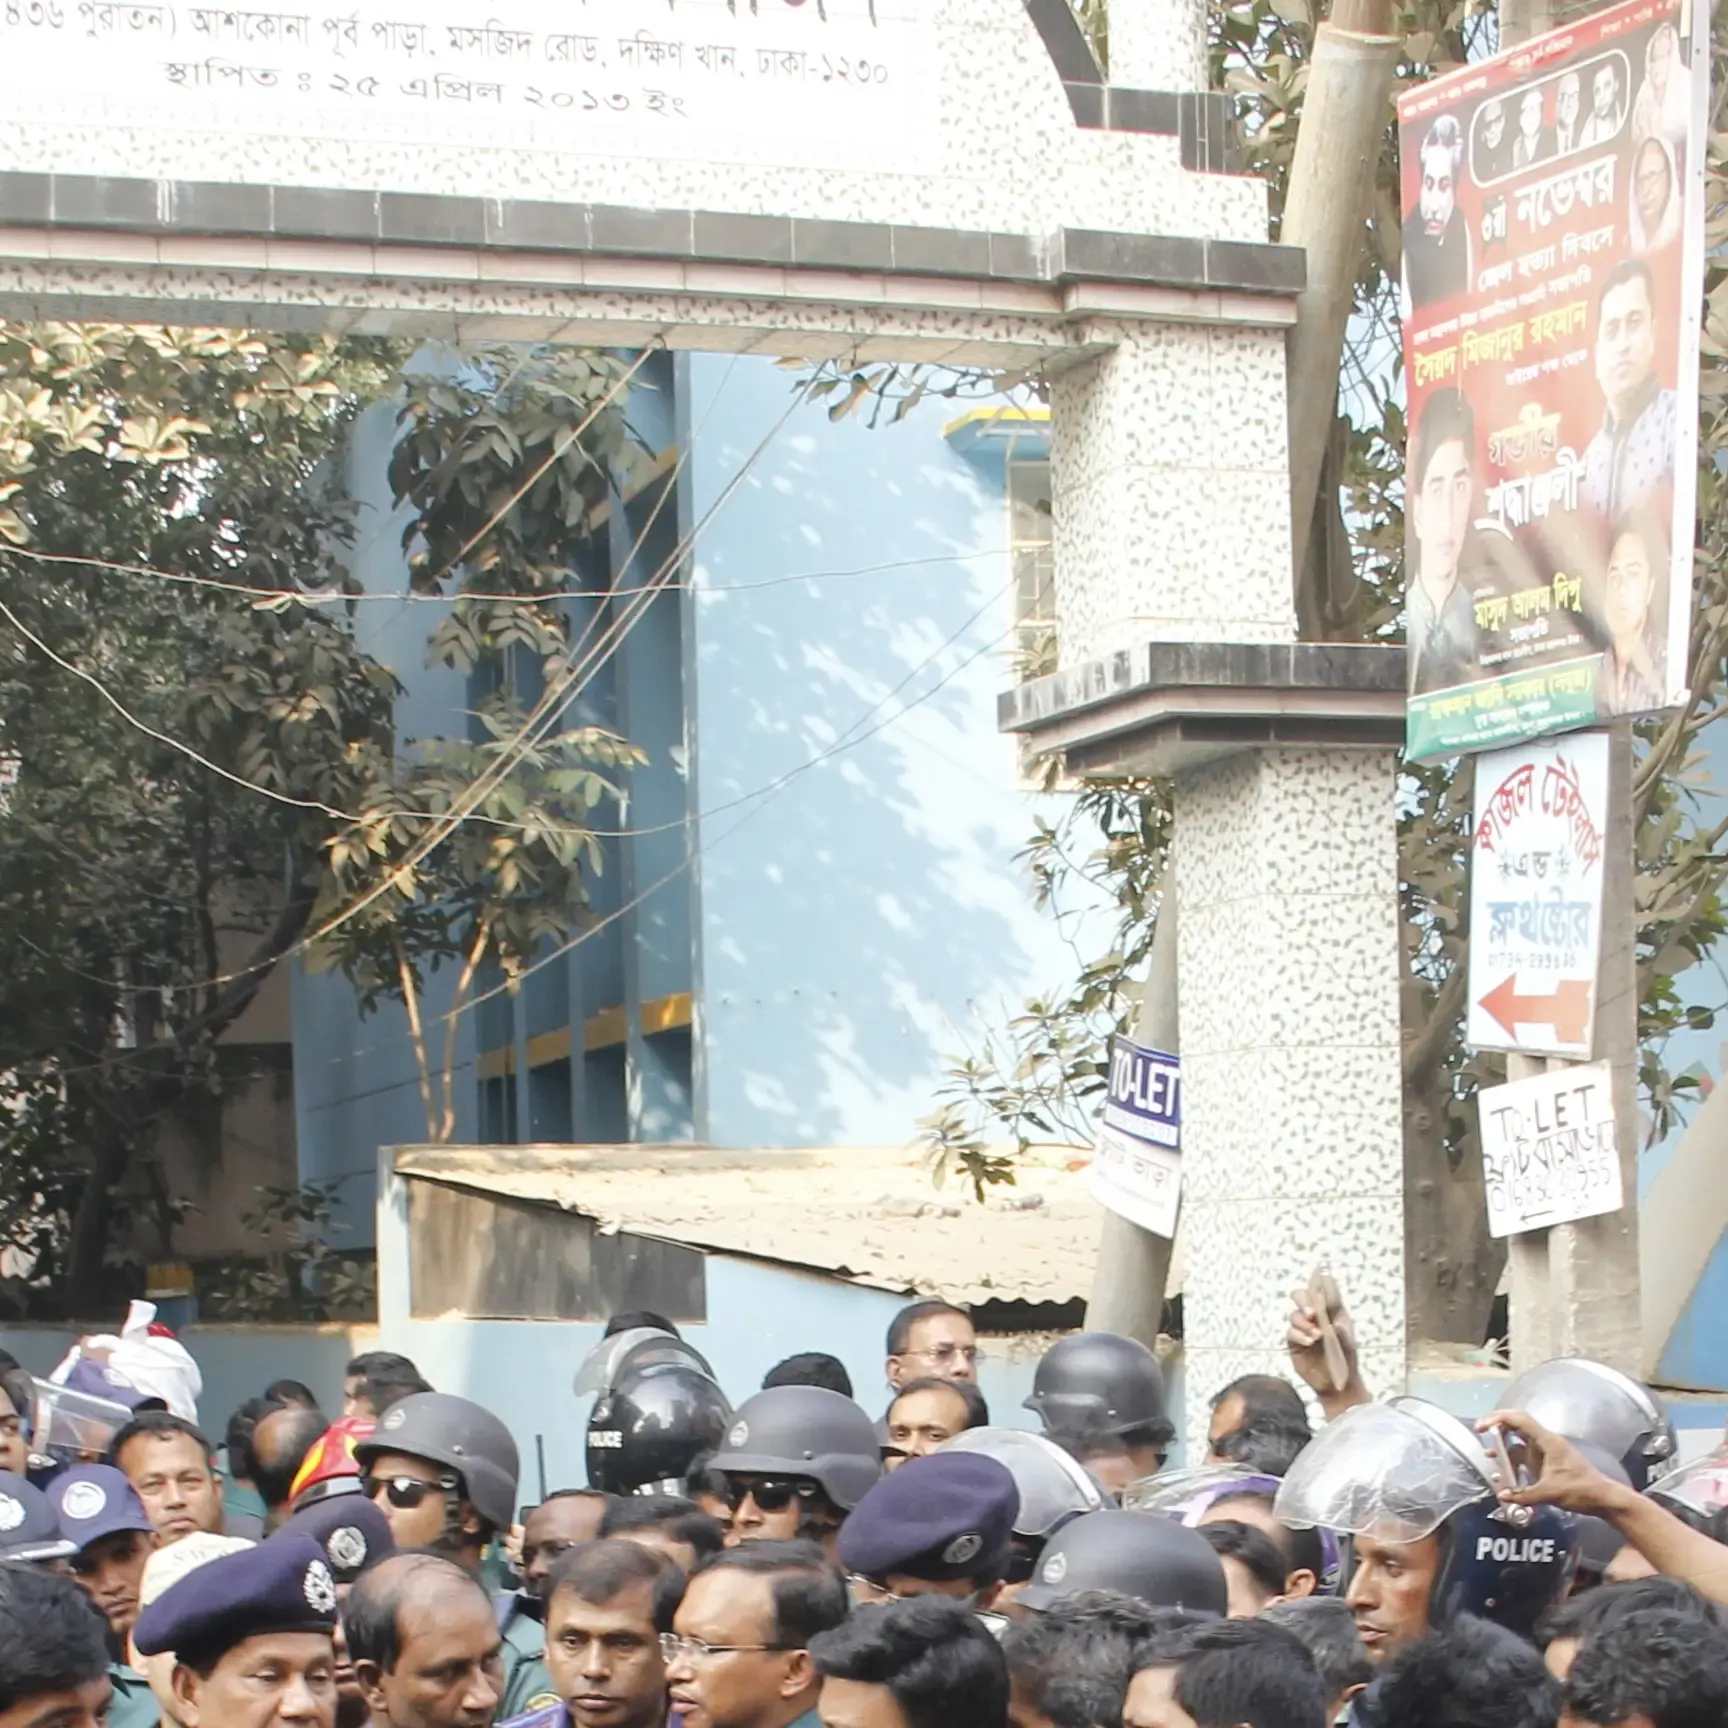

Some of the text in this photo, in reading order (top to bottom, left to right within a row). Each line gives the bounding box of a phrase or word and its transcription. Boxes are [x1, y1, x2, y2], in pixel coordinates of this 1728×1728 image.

[187, 7, 310, 46] আশকোনা
[321, 9, 363, 61] পূর্ব
[444, 19, 534, 62] মসজিদ
[617, 28, 685, 71] দক্ষিণ
[755, 48, 889, 85] ঢাকা-১২৩০
[162, 56, 282, 90] স্থাপিত
[328, 73, 382, 98] ২৫
[399, 72, 507, 105] এপ্রিল
[523, 85, 630, 112] ২০১৩
[1513, 153, 1619, 234] নভেম্বর
[1461, 321, 1526, 370] মিজানুর
[1528, 300, 1589, 345] রহমান
[1109, 1048, 1179, 1117] TO-LET
[1475, 1536, 1555, 1563] POLICE
